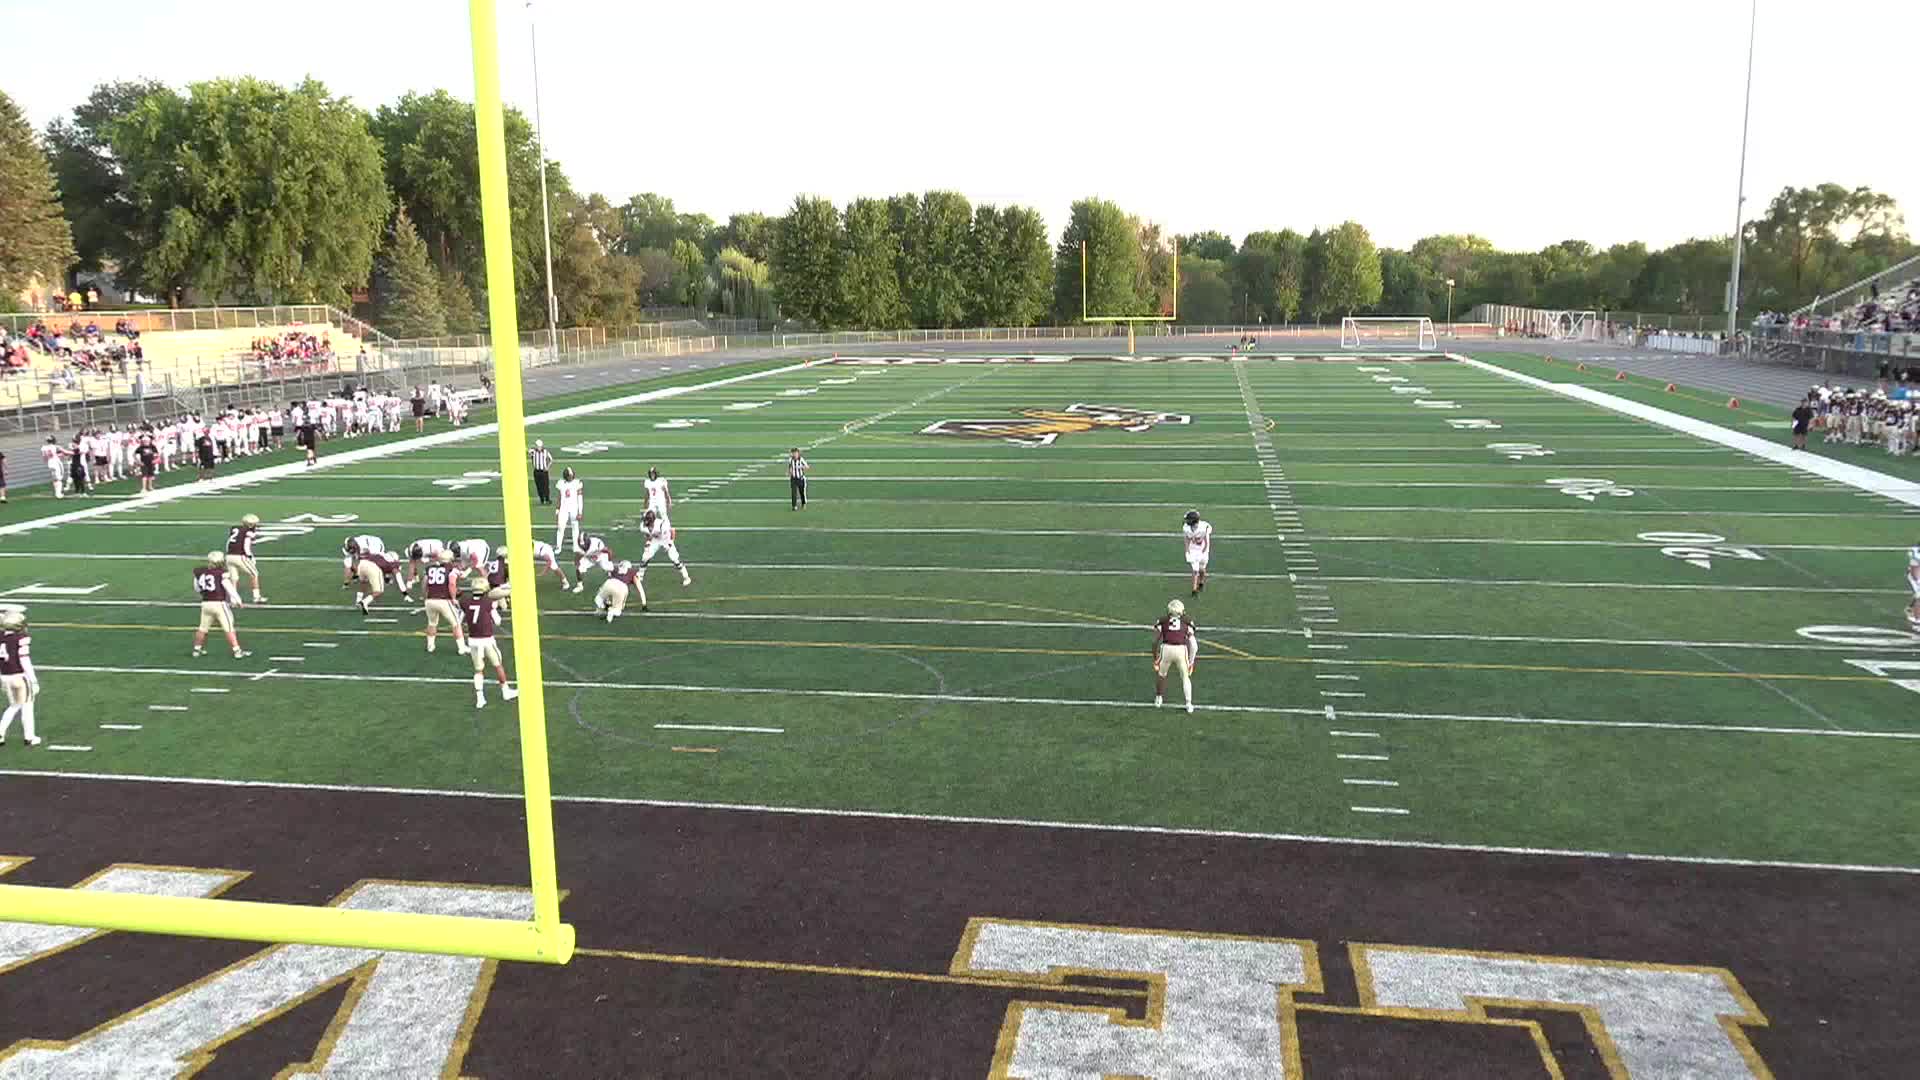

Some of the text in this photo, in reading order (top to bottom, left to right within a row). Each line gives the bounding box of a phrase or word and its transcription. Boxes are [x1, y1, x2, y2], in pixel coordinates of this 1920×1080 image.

[230, 527, 240, 543] 2
[198, 573, 216, 592] 43
[428, 566, 447, 585] 96
[468, 604, 481, 625] 7
[1168, 616, 1181, 631] 3
